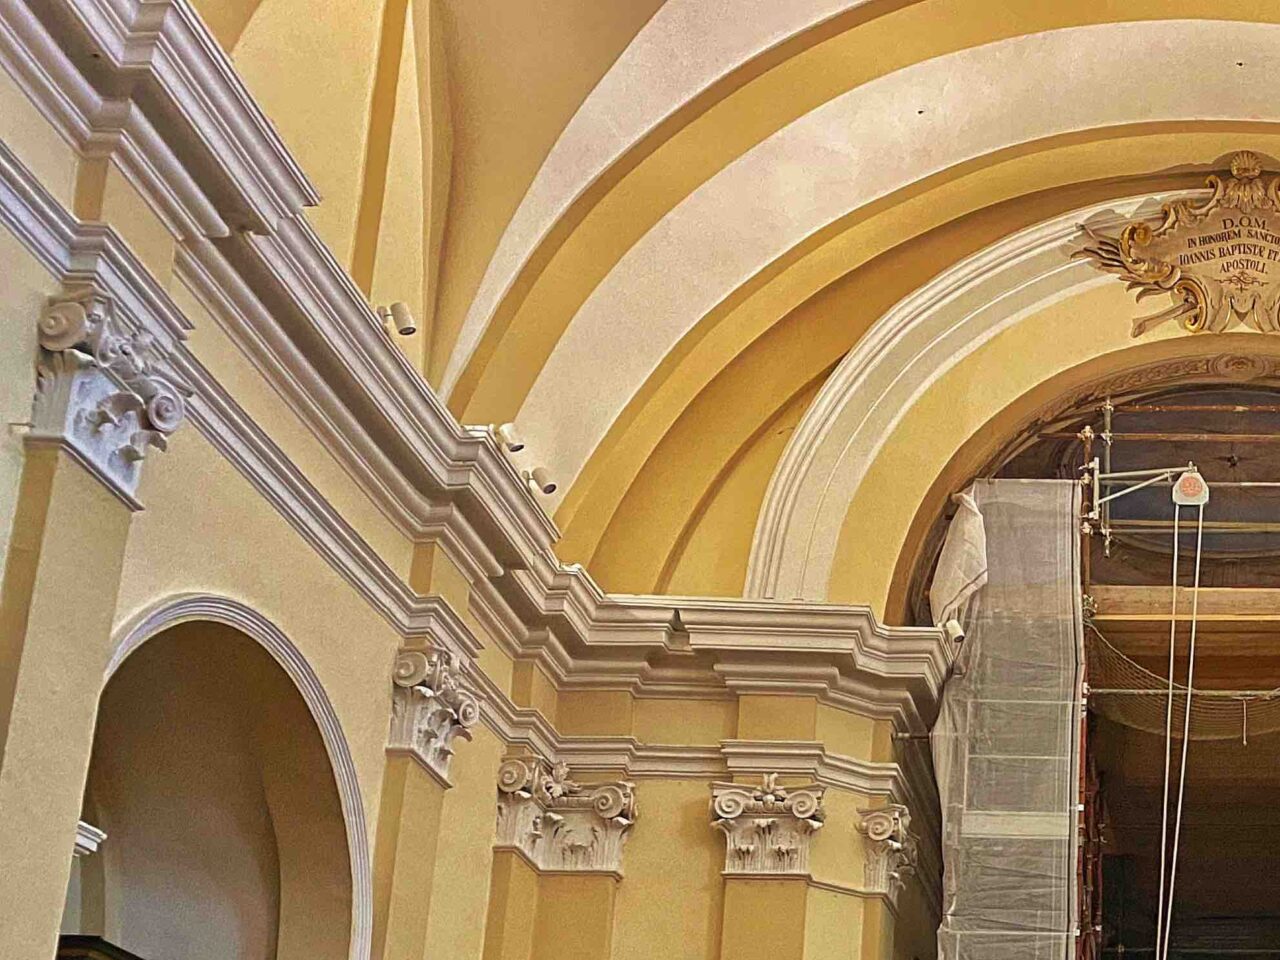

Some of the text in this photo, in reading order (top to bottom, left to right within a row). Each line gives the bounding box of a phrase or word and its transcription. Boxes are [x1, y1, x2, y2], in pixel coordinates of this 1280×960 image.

[1187, 238, 1197, 248] IN
[1199, 229, 1241, 246] HONOREM
[1179, 248, 1216, 266] IOANNIS
[1267, 249, 1278, 261] ET
